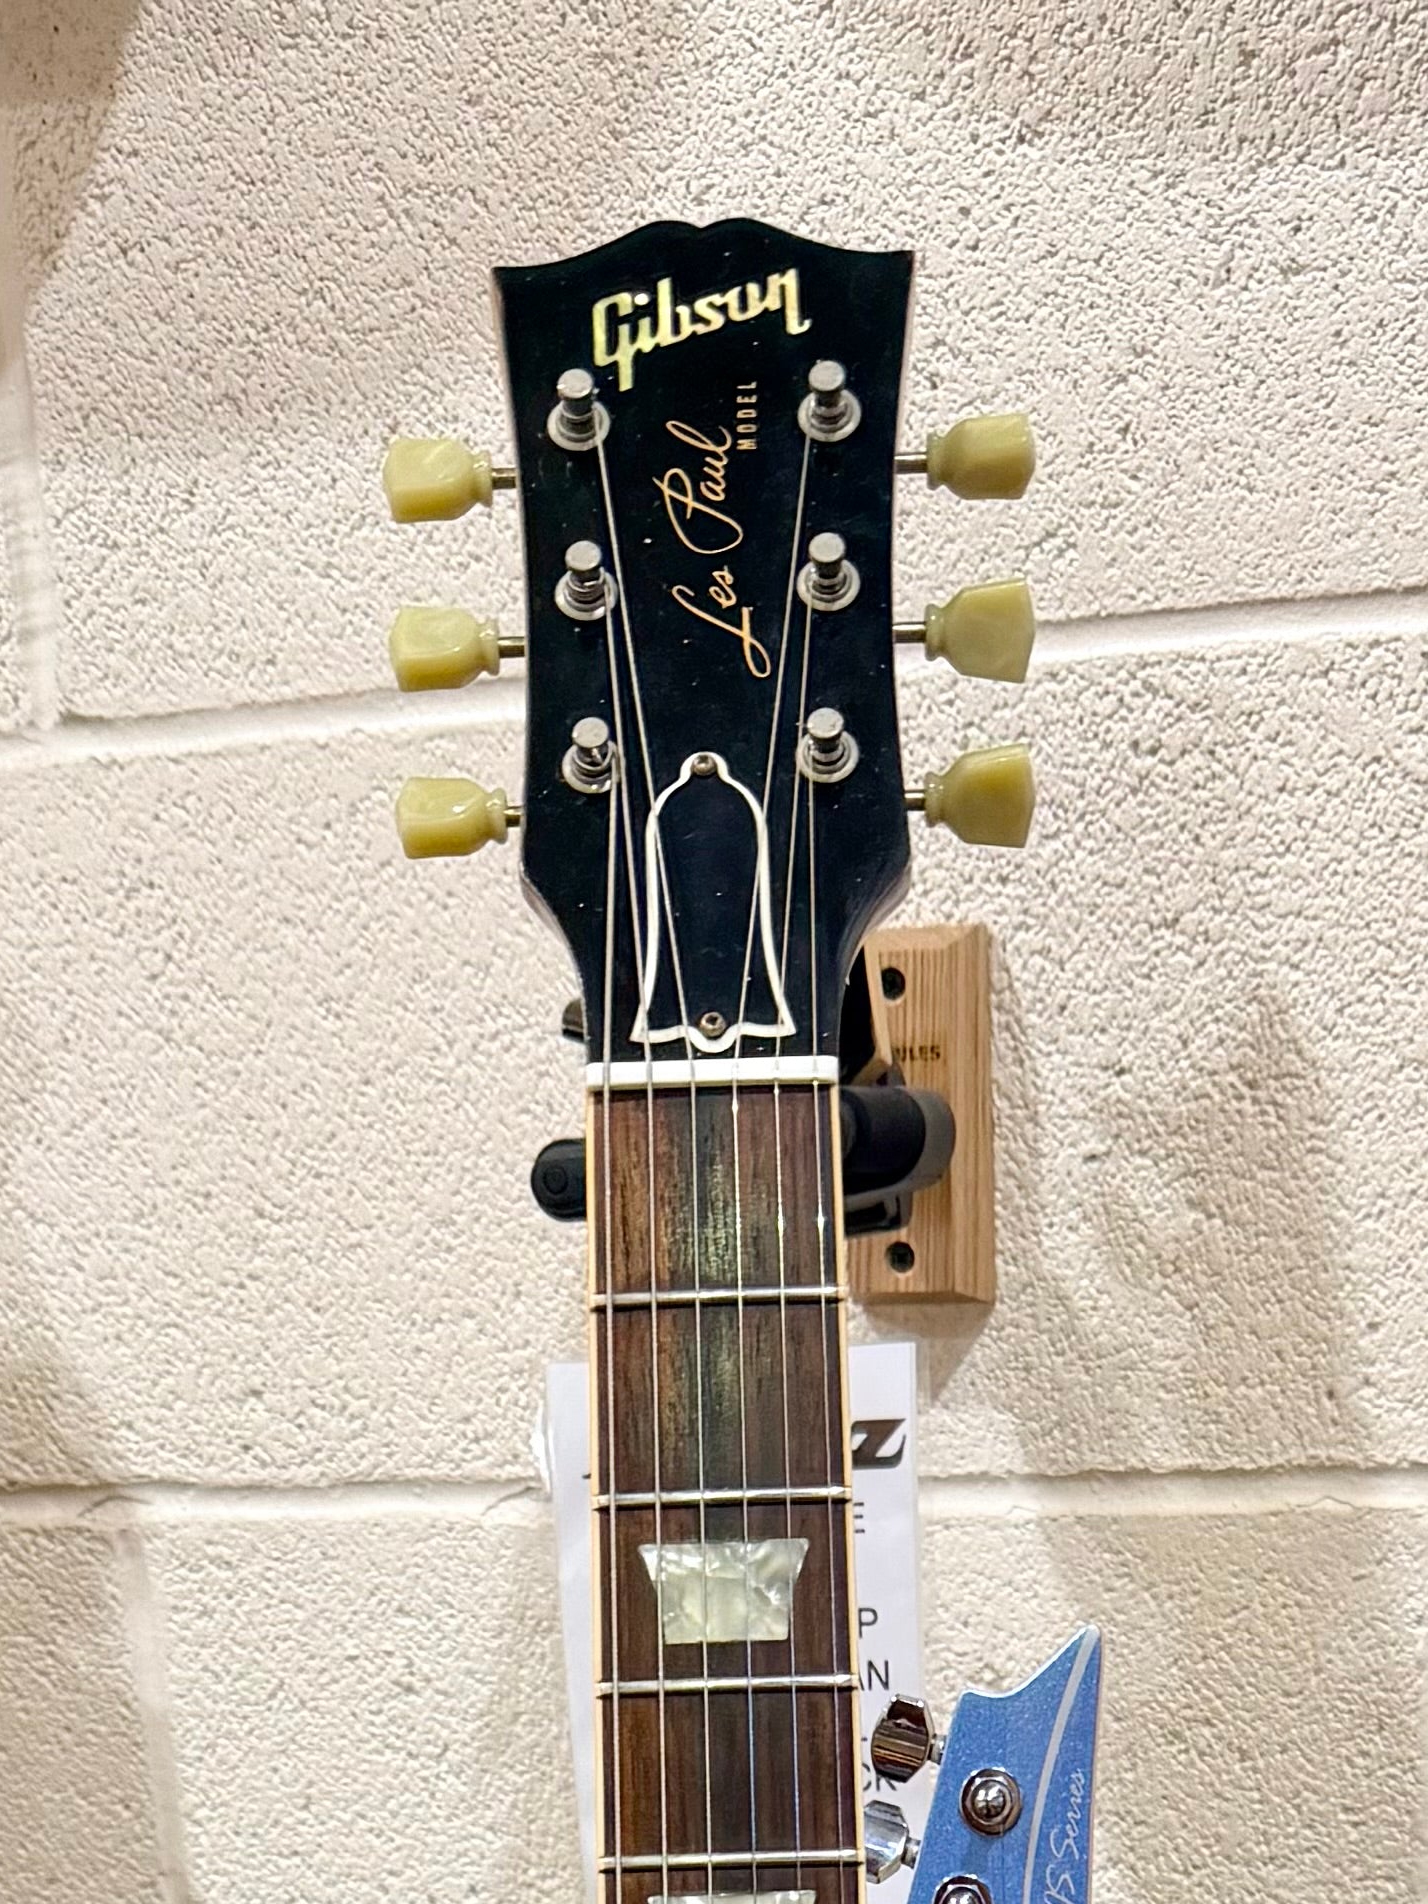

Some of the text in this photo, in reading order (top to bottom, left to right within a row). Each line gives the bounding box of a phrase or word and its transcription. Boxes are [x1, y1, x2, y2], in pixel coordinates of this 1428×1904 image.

[591, 267, 812, 392] Gibson
[736, 380, 758, 451] MODEL
[652, 420, 771, 678] Les Paul
[1049, 1767, 1086, 1860] Series
